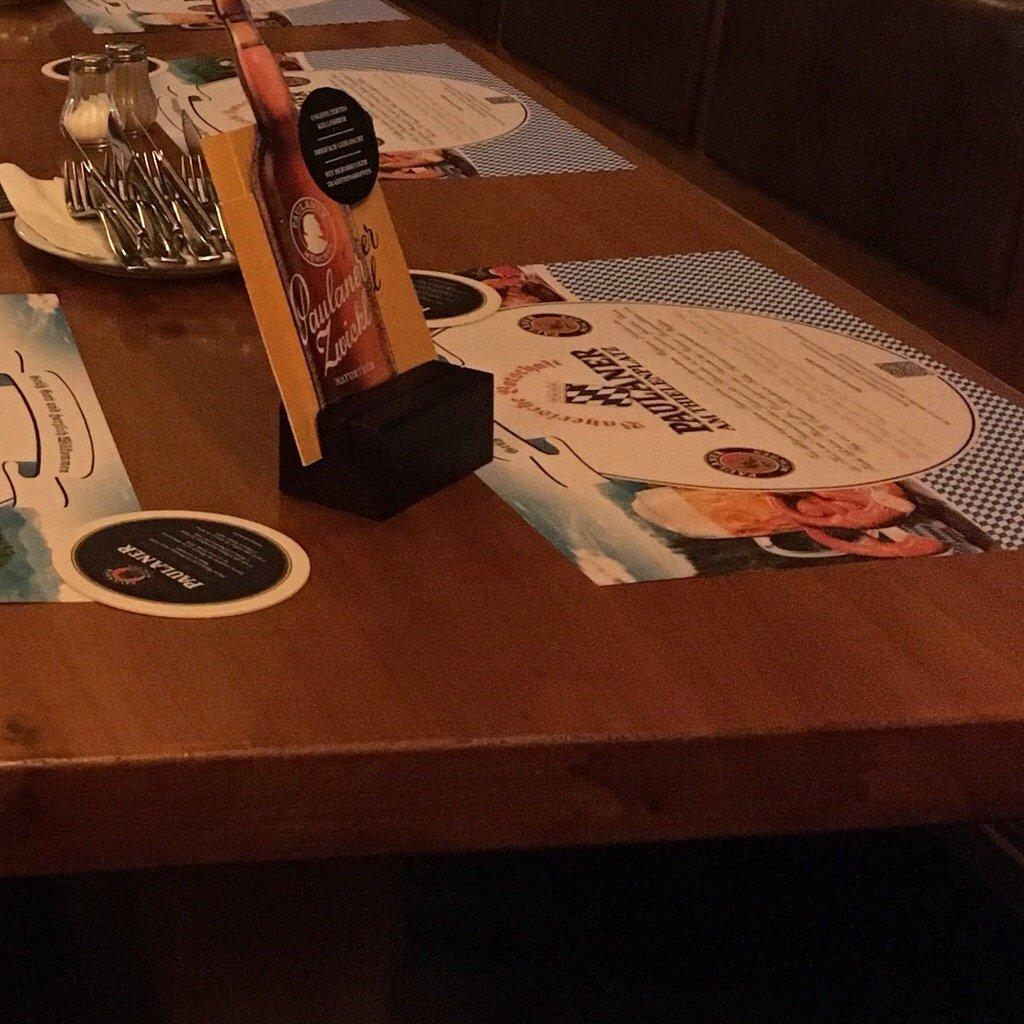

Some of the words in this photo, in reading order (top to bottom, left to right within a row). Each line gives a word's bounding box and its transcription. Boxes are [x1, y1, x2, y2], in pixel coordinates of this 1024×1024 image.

[570, 347, 714, 435] PAULANER
[601, 345, 707, 417] THIELENPLATZ
[702, 414, 736, 431] AM
[117, 543, 205, 590] PAULANER
